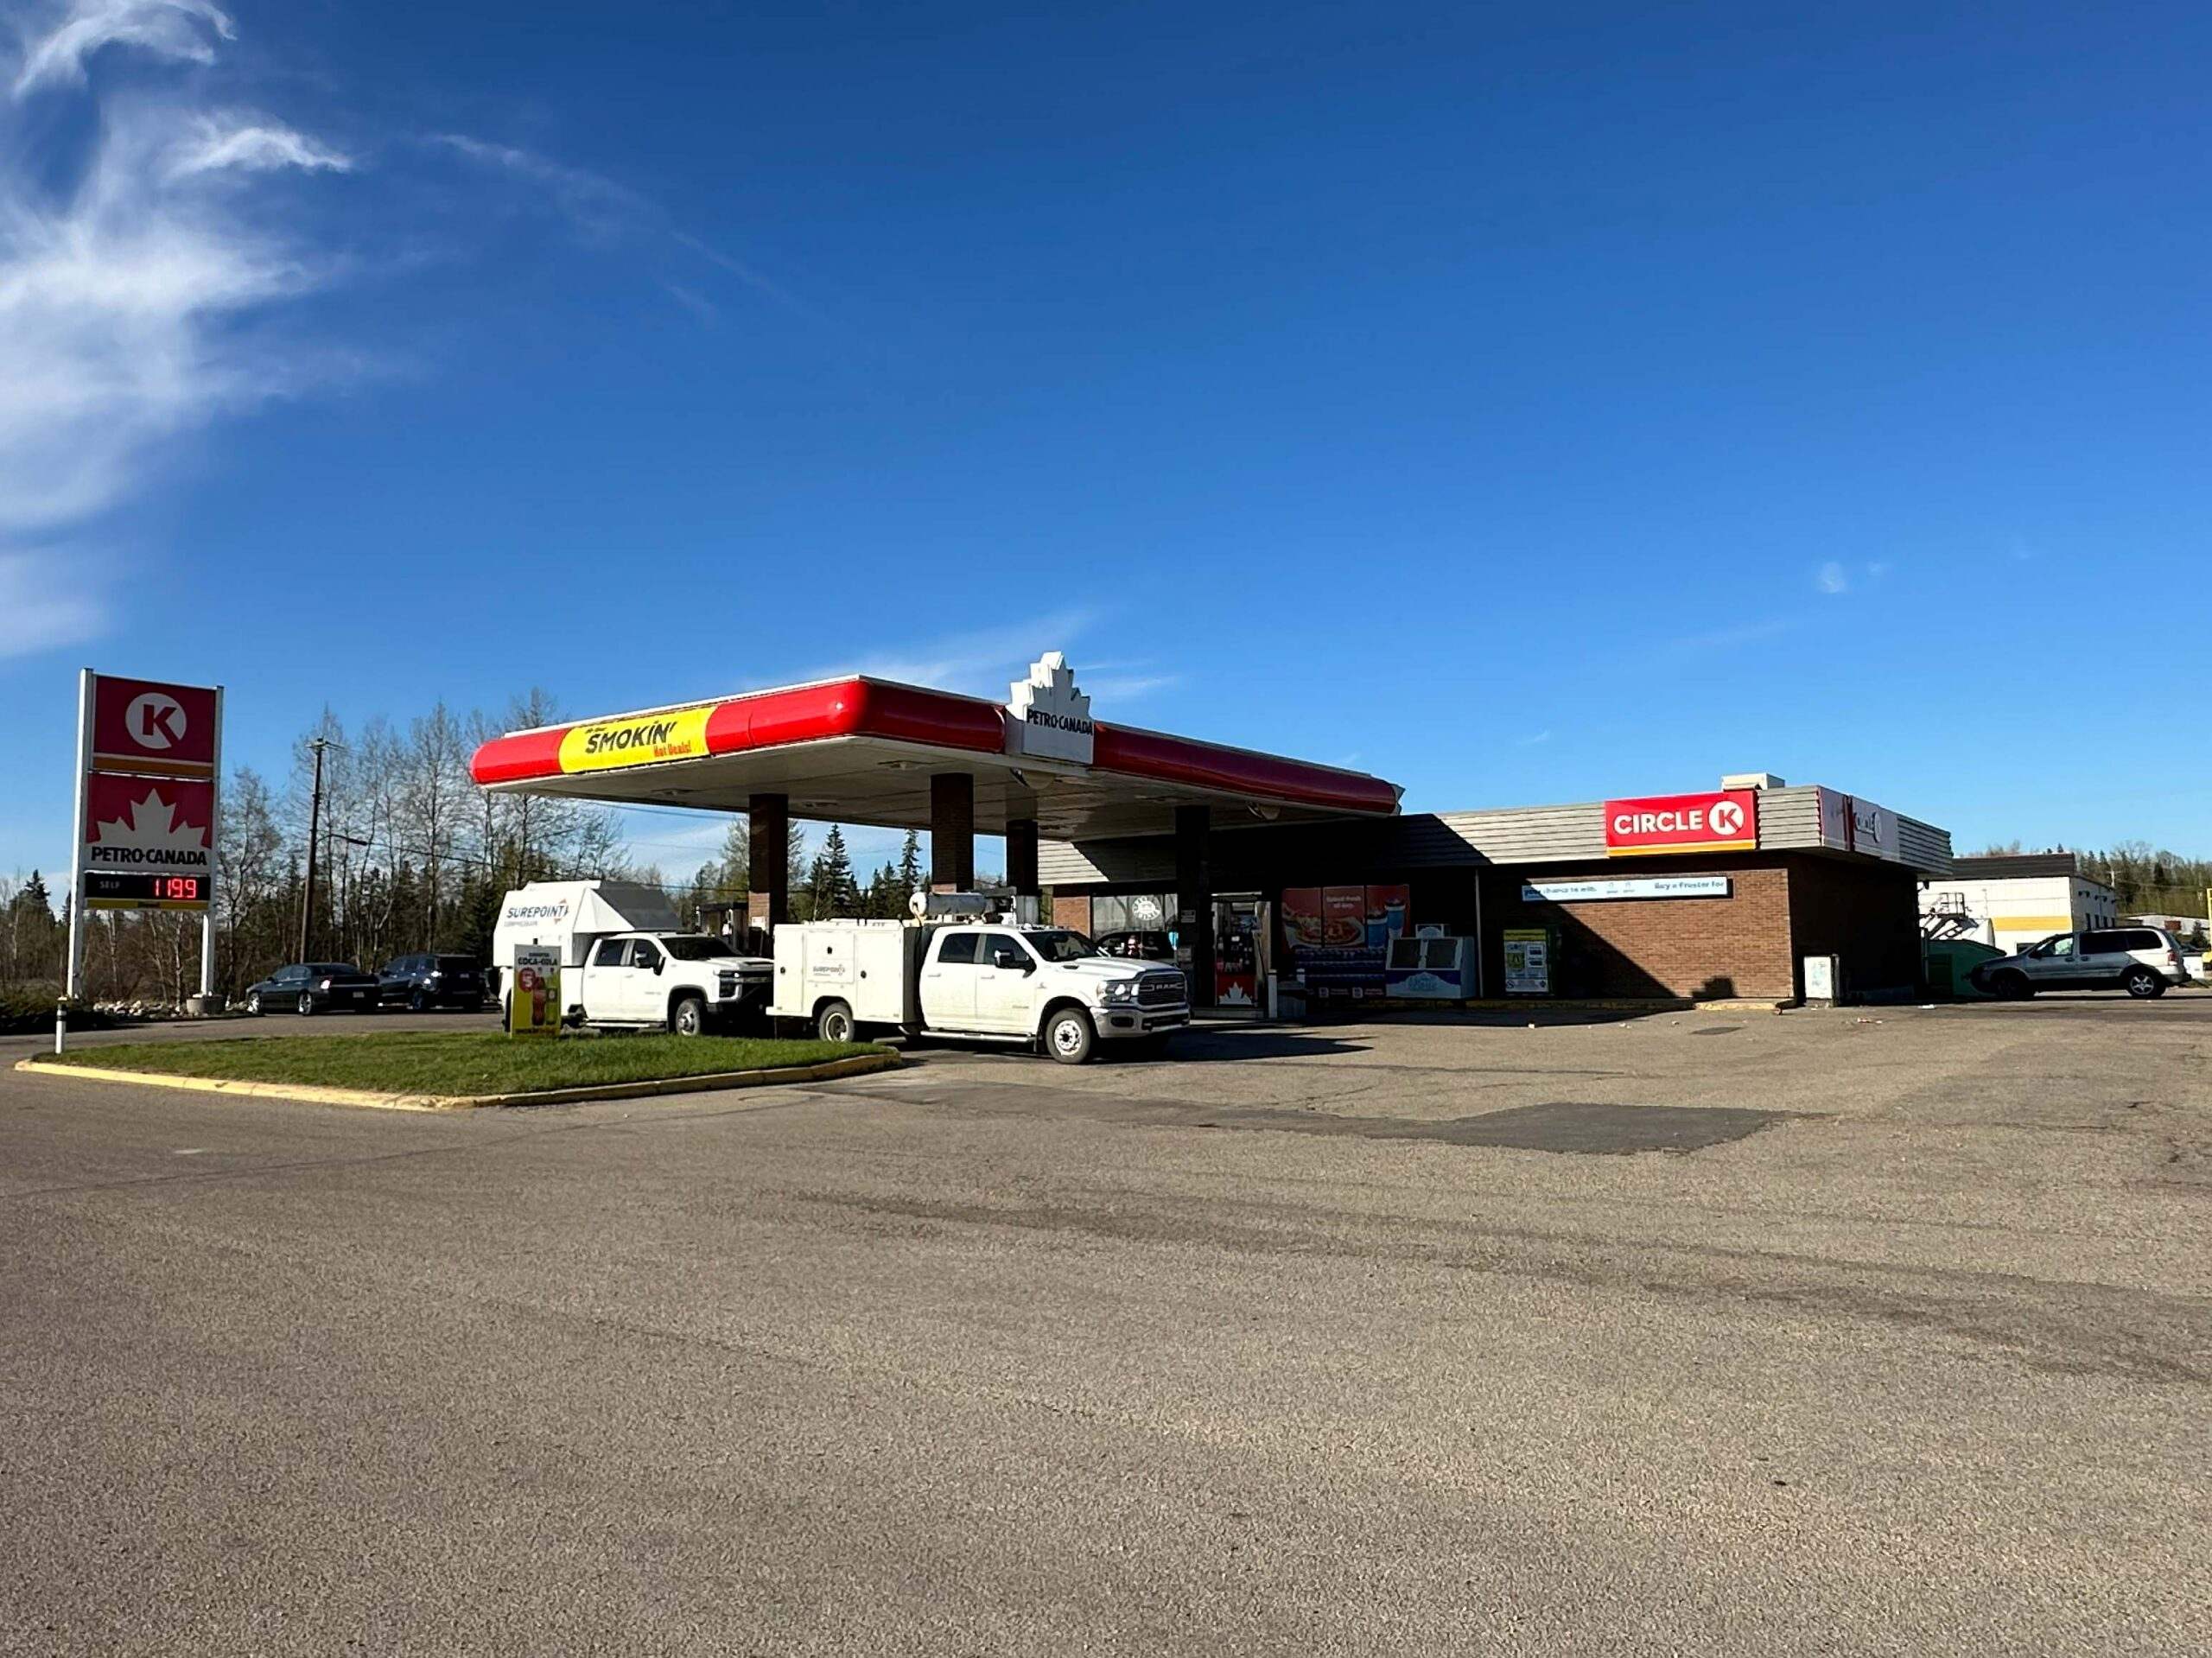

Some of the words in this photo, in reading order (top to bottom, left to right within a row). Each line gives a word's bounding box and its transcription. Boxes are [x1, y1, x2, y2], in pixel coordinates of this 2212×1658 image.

[585, 721, 677, 754] SMOKIN'
[1614, 810, 1703, 835] CIRCLE
[91, 846, 208, 866] PETRO-CANADA
[99, 880, 120, 890] SELF
[506, 905, 566, 918] SUREPOINT
